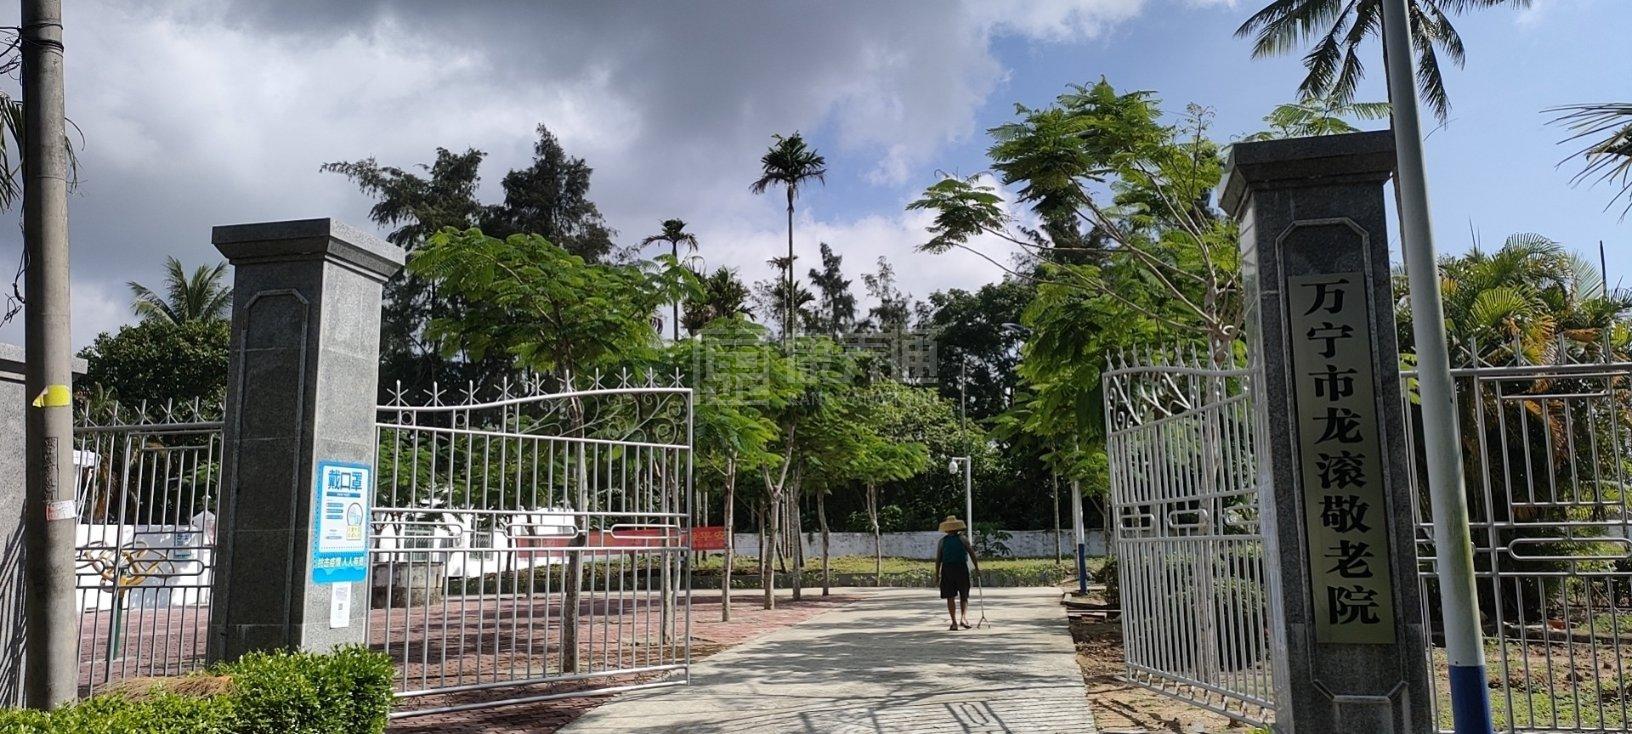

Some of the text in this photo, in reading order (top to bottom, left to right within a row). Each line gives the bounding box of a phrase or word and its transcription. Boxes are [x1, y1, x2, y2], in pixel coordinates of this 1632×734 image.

[327, 470, 362, 491] 戴口罩
[1301, 278, 1381, 625] 万宁市龙滚敬老院
